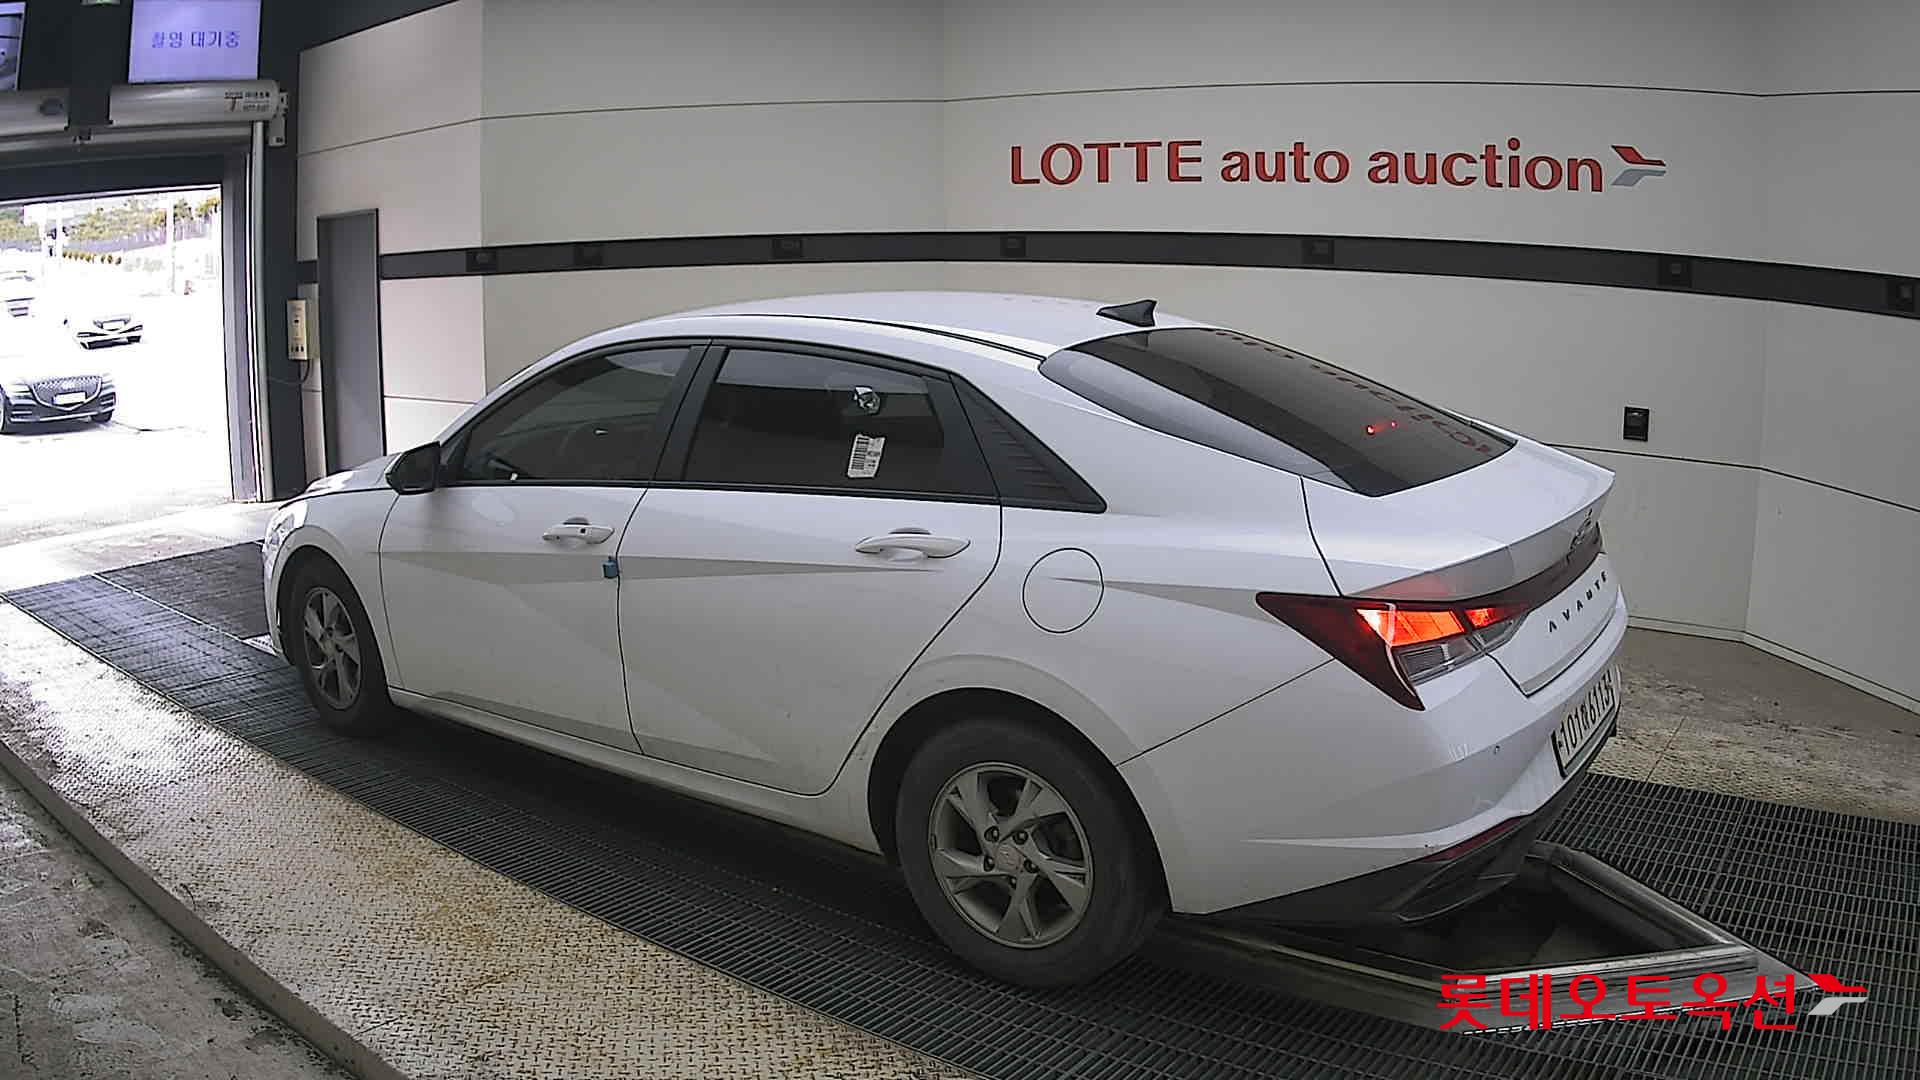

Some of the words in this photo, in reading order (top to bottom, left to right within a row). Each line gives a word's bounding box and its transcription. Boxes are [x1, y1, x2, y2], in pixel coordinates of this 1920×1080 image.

[191, 31, 240, 48] 대기중
[1010, 140, 1202, 185] LOTTE
[1220, 142, 1350, 183] auto
[1367, 137, 1603, 192] auction
[1548, 570, 1607, 633] AVANTE
